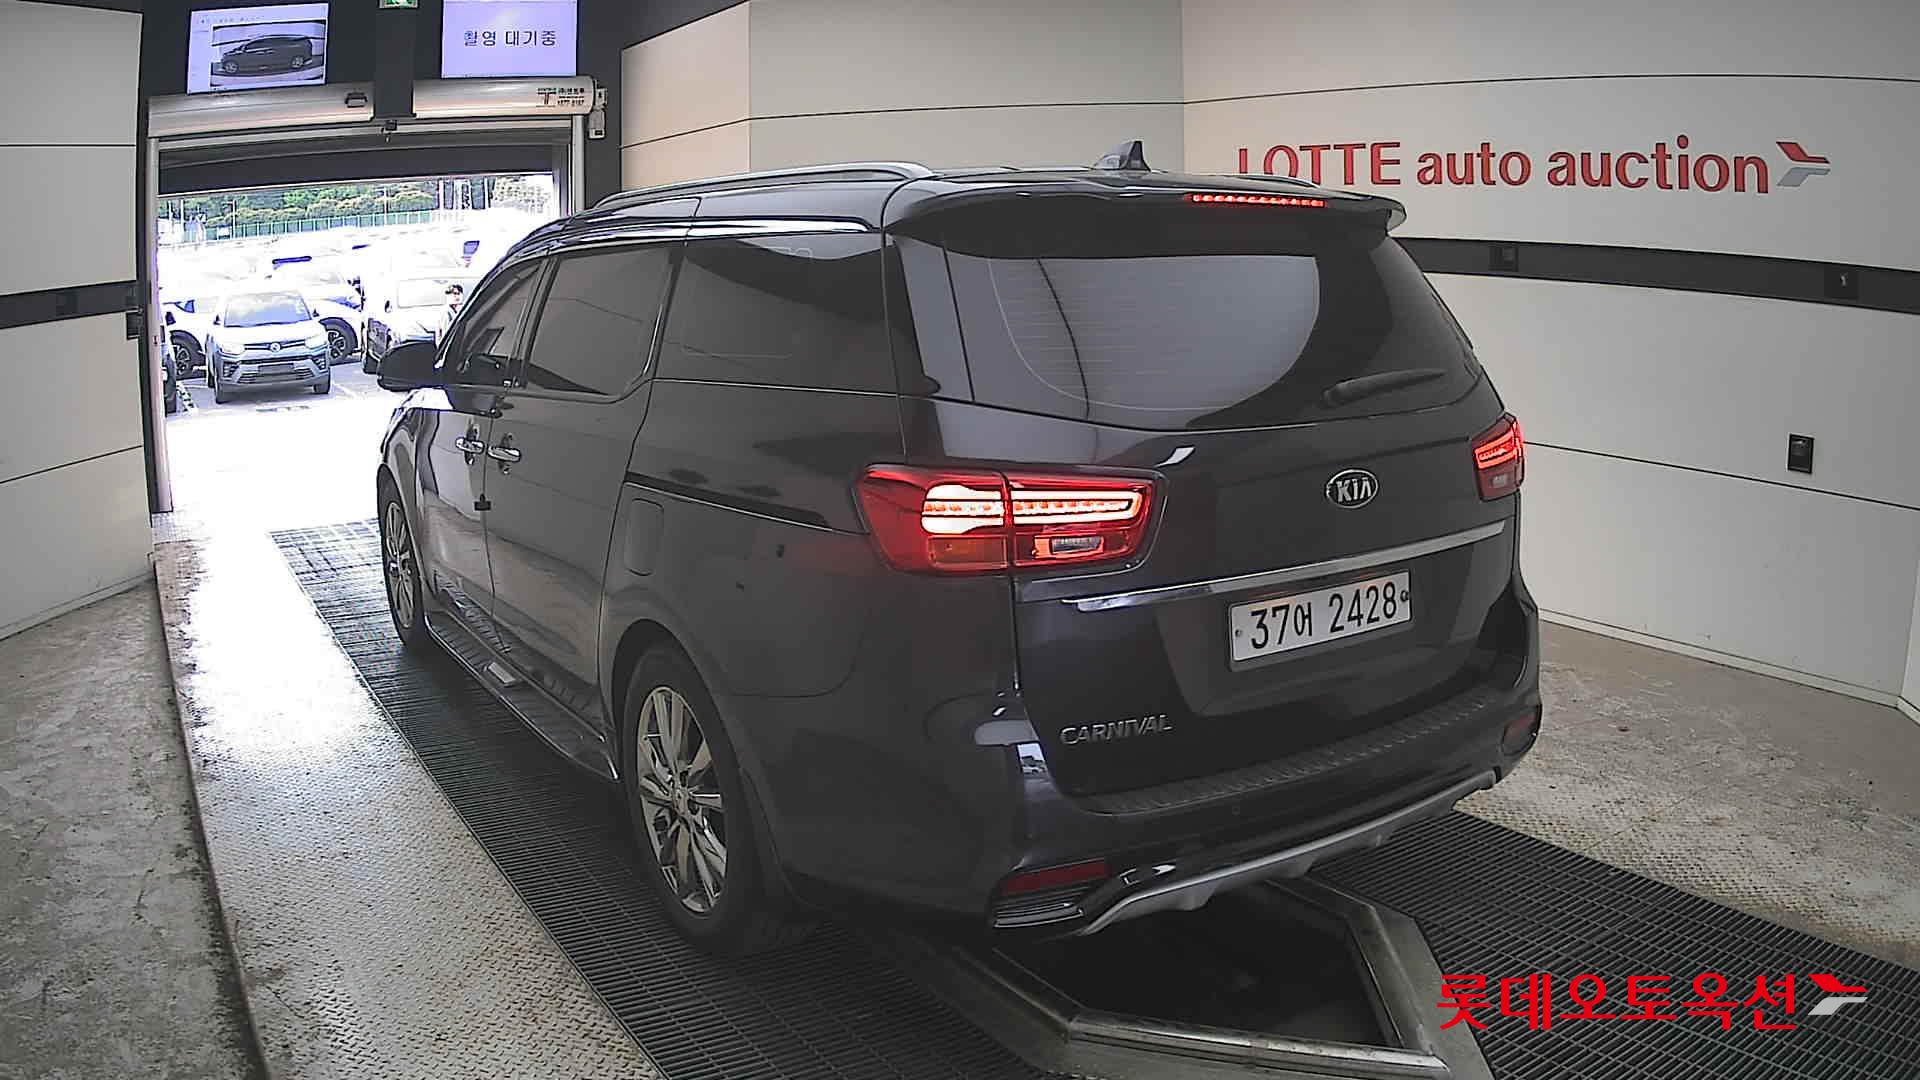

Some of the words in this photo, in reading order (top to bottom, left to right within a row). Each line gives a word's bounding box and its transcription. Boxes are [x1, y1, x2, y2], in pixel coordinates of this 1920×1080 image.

[504, 30, 557, 47] 대기중
[1416, 142, 1532, 186] auto
[1547, 134, 1769, 194] auction
[1333, 475, 1373, 504] KIA
[1250, 602, 1313, 650] 37어
[1328, 581, 1398, 634] 2428
[1060, 714, 1173, 744] CARNIVAL
